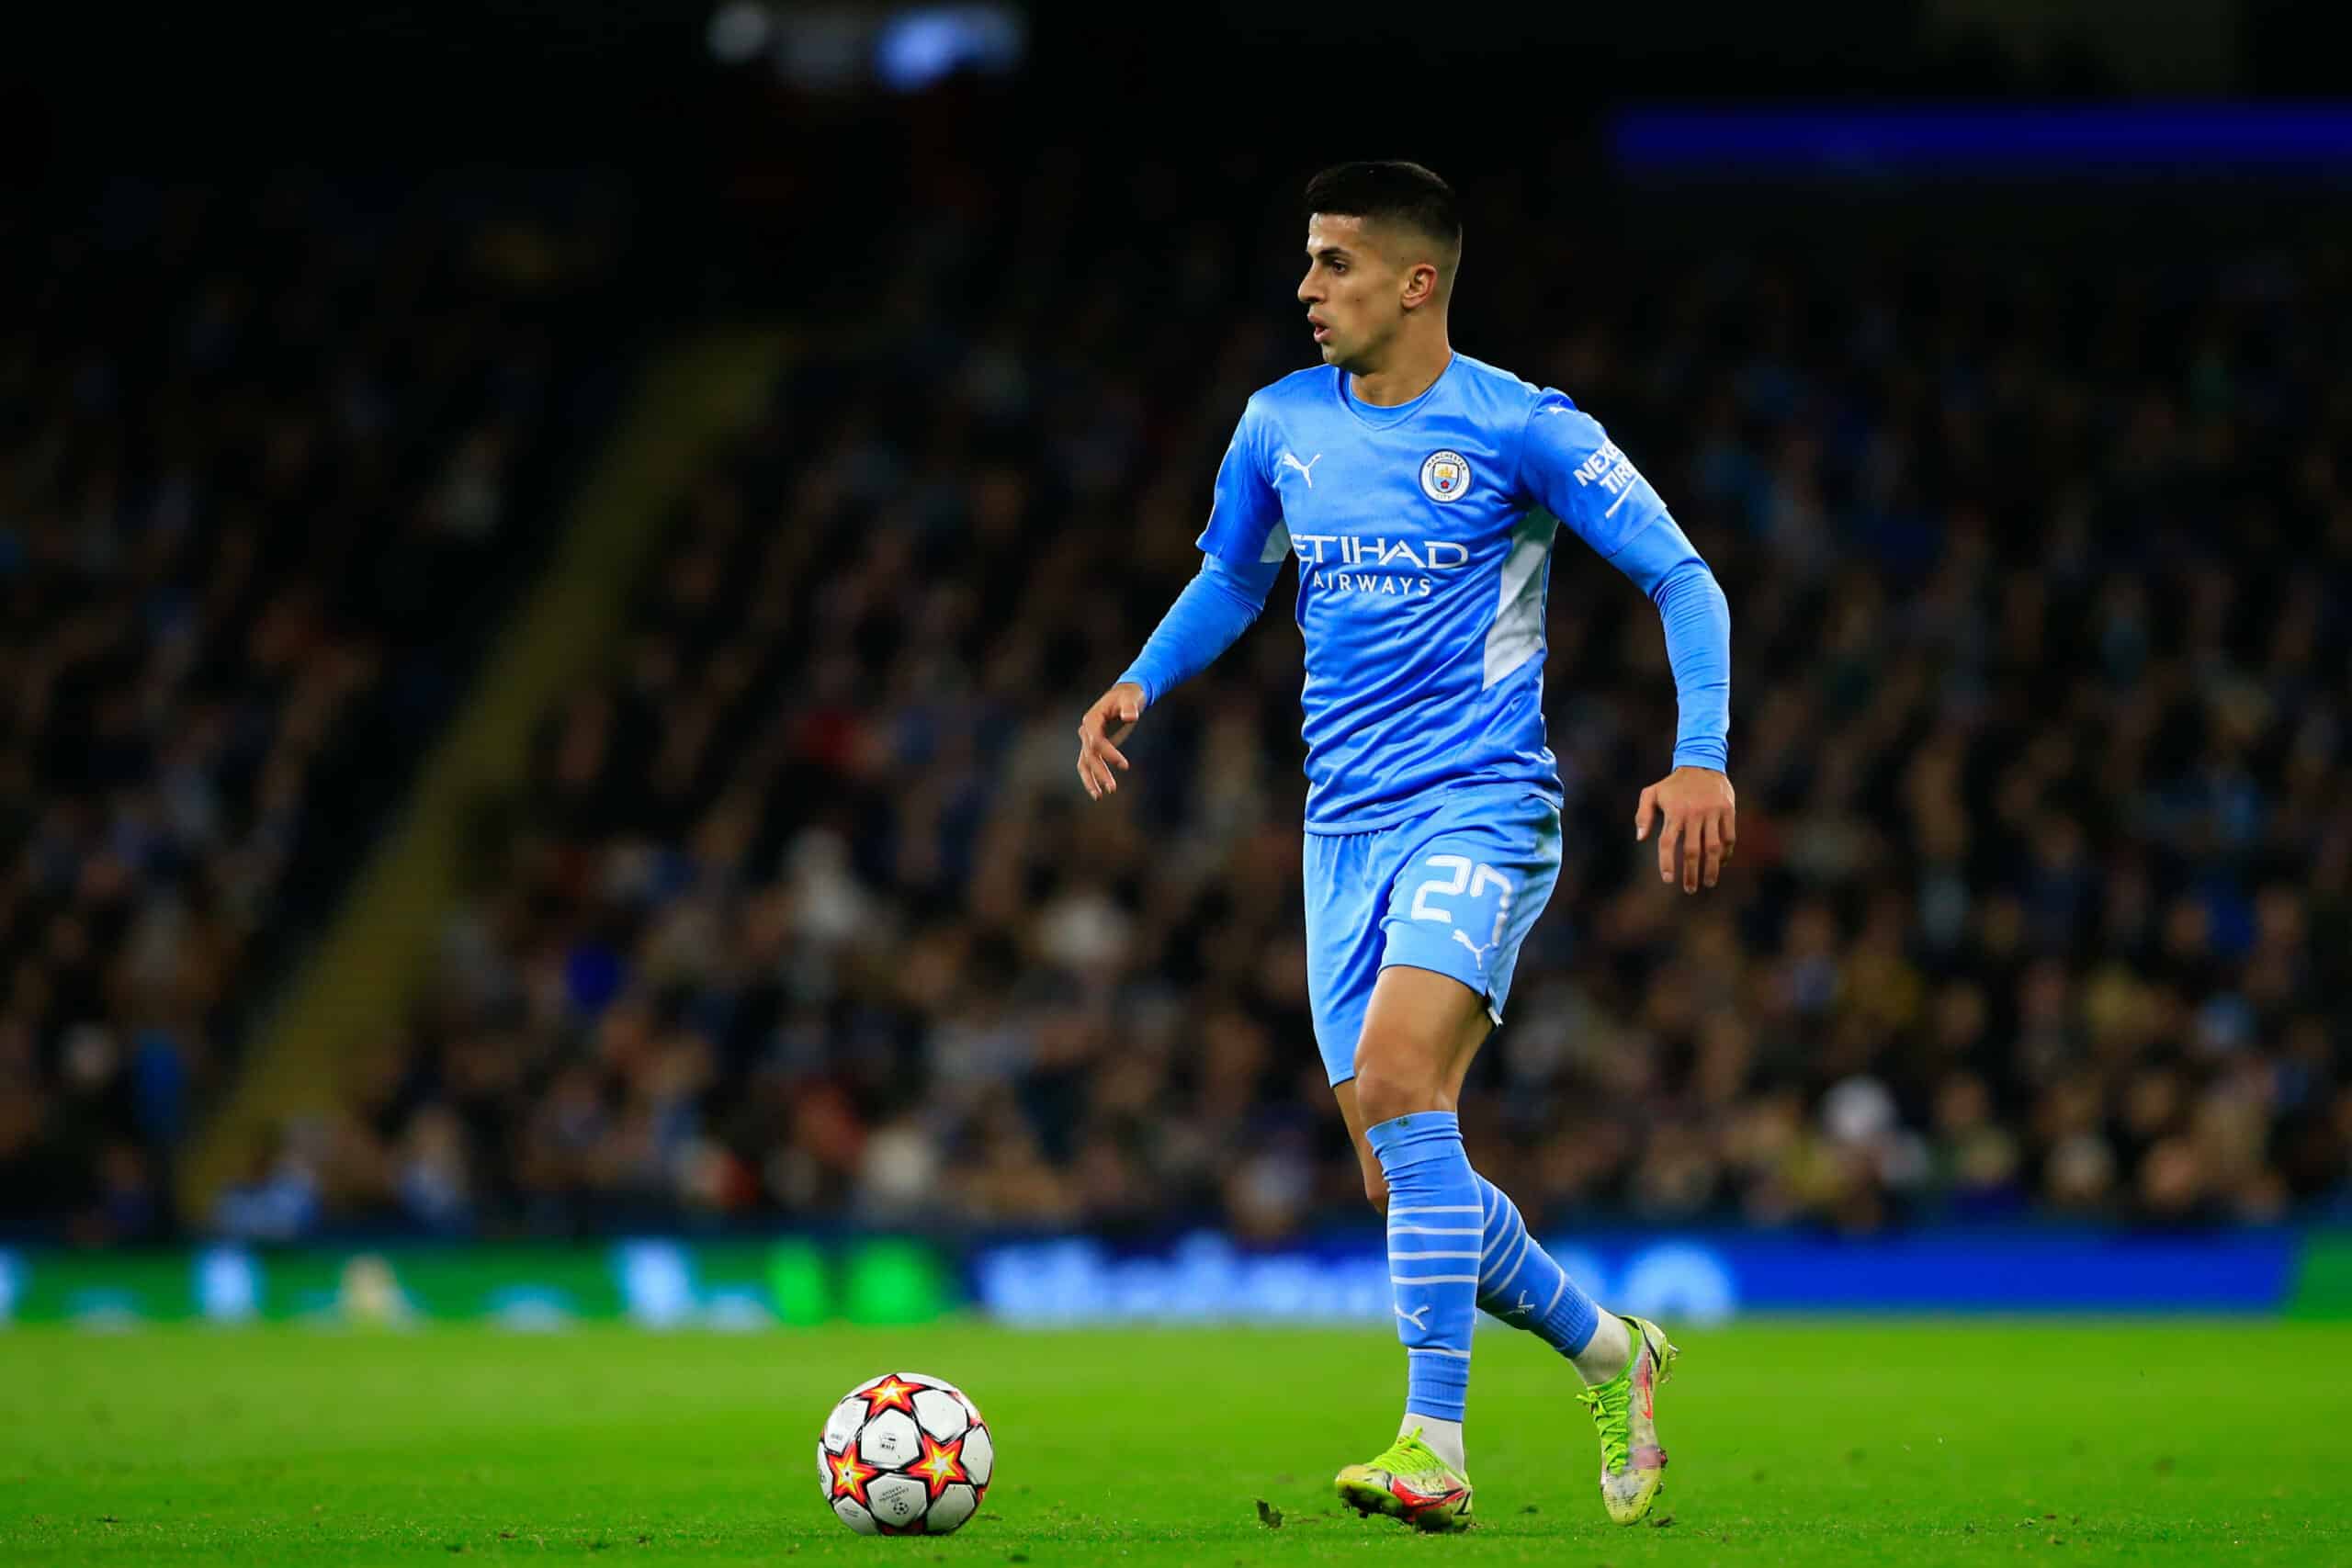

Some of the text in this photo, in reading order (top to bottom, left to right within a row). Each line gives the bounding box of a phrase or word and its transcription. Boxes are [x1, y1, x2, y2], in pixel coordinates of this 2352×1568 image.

[1290, 534, 1469, 570] ETIHAD
[1312, 570, 1431, 597] AIRWAYS
[1411, 854, 1513, 947] 27
